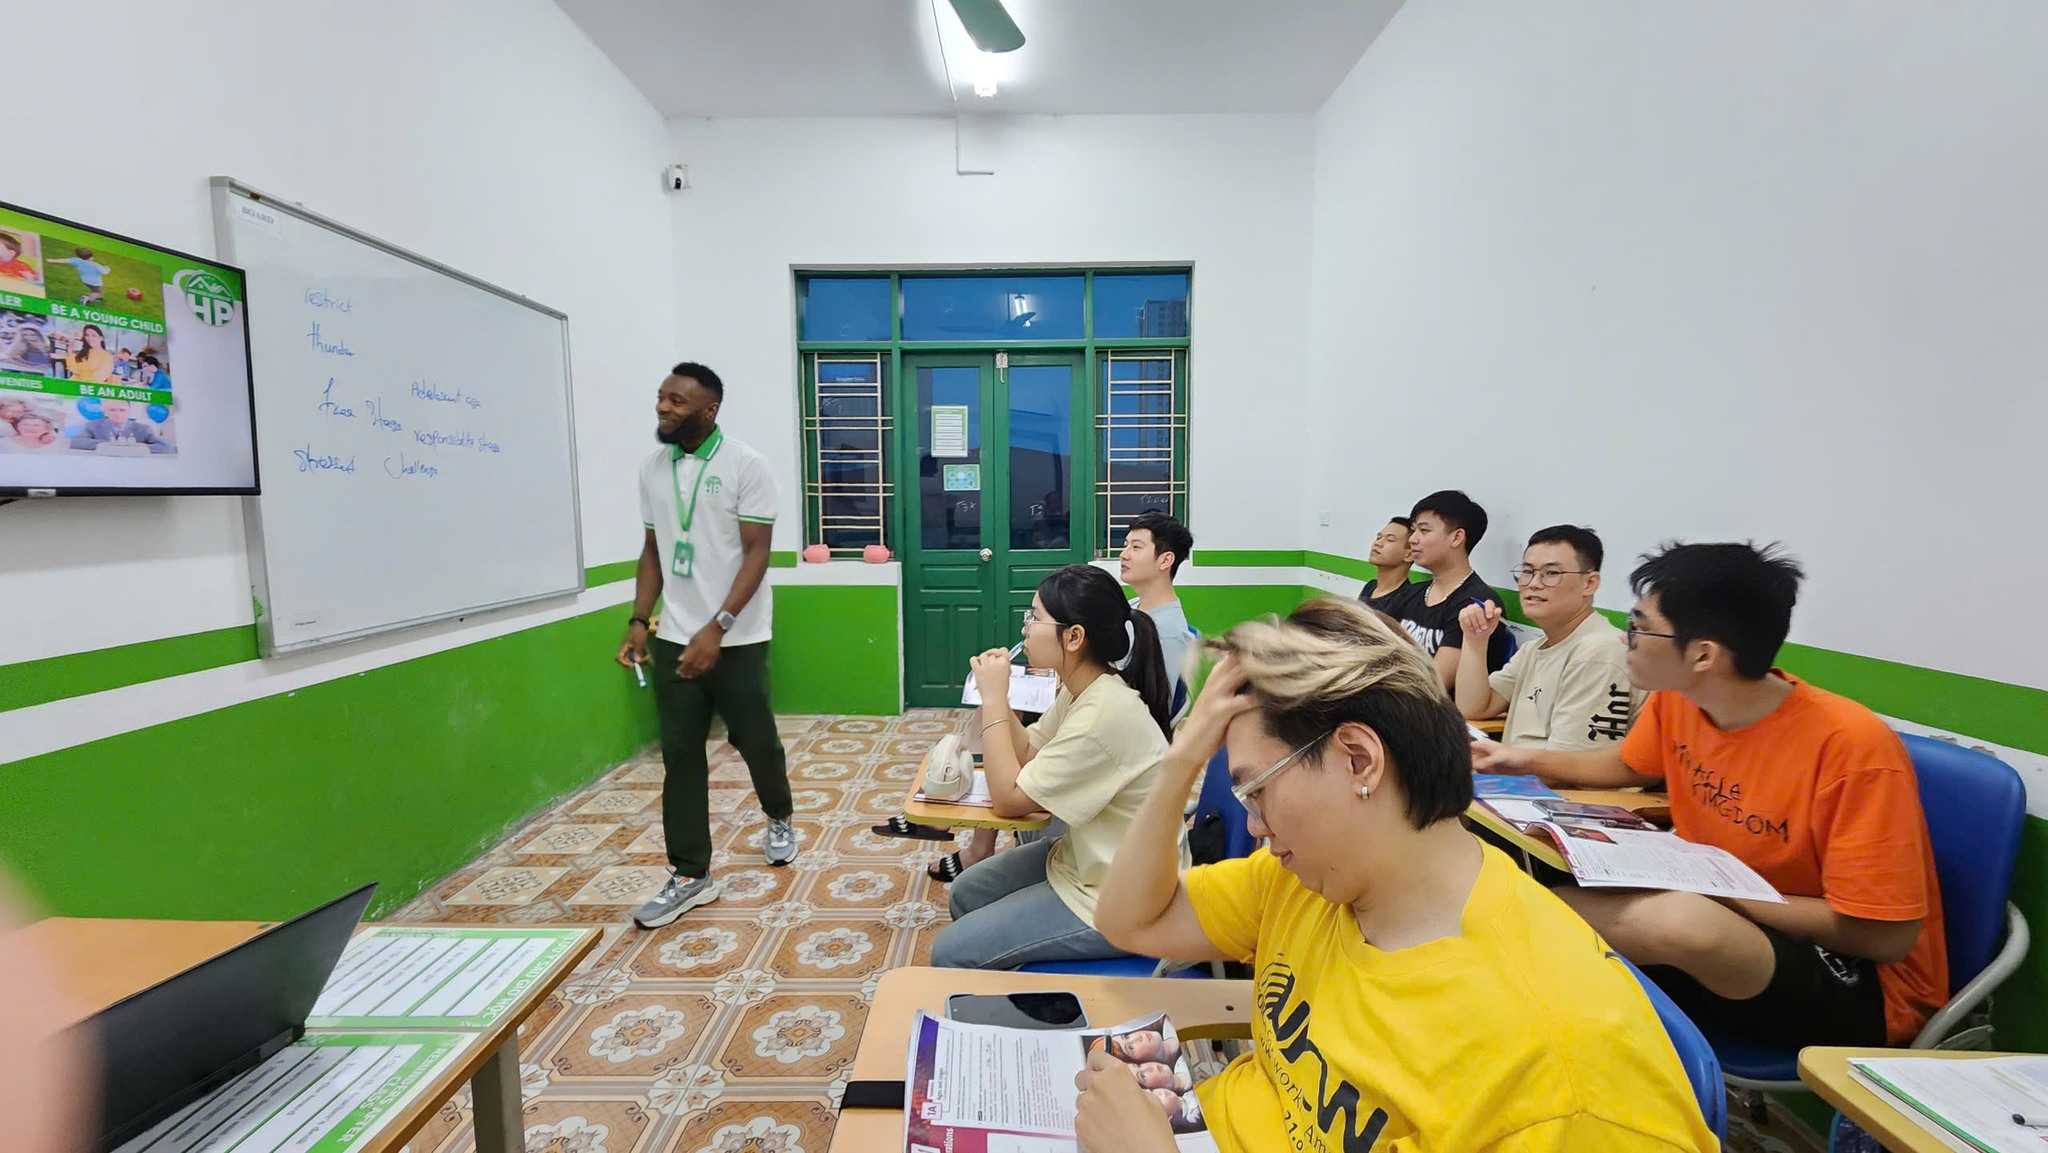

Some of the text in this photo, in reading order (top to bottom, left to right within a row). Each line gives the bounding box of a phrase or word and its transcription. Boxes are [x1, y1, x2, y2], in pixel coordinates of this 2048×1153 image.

[241, 206, 274, 224] BOARD
[51, 303, 164, 333] BE A YOUNG CHILD
[187, 293, 234, 327] HP
[80, 384, 152, 401] BE AN ADULT
[336, 1047, 448, 1143] REMINDERS AFTER
[360, 1076, 401, 1108] CLASS
[927, 1105, 937, 1116] 1A
